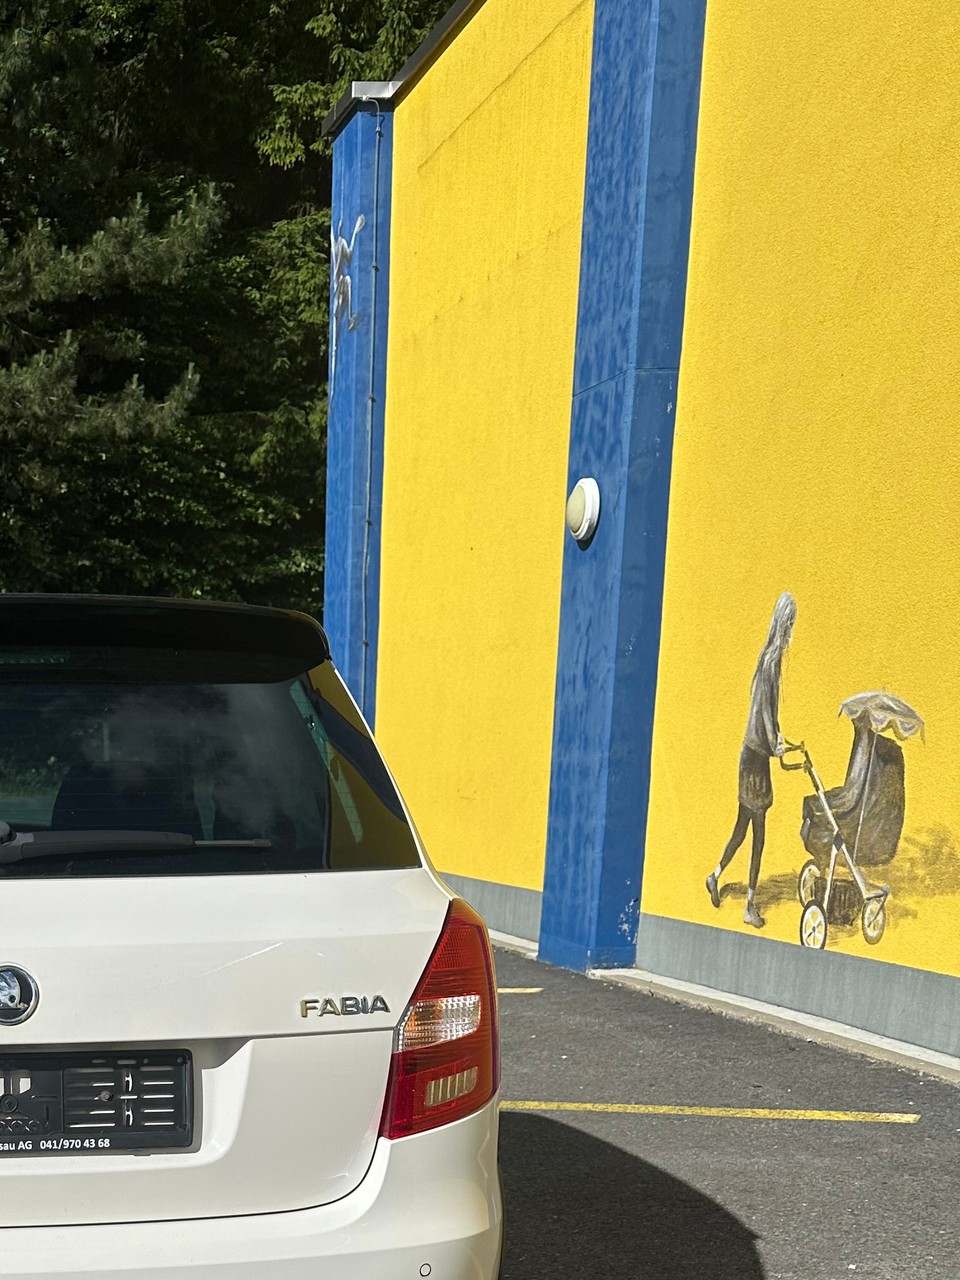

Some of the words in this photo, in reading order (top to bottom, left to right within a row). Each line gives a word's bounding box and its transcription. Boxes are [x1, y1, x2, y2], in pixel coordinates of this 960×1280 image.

[300, 995, 390, 1017] FABIA
[17, 1140, 33, 1150] AG
[40, 1139, 81, 1150] 041/970
[83, 1139, 95, 1148] 43
[97, 1138, 111, 1148] 68
